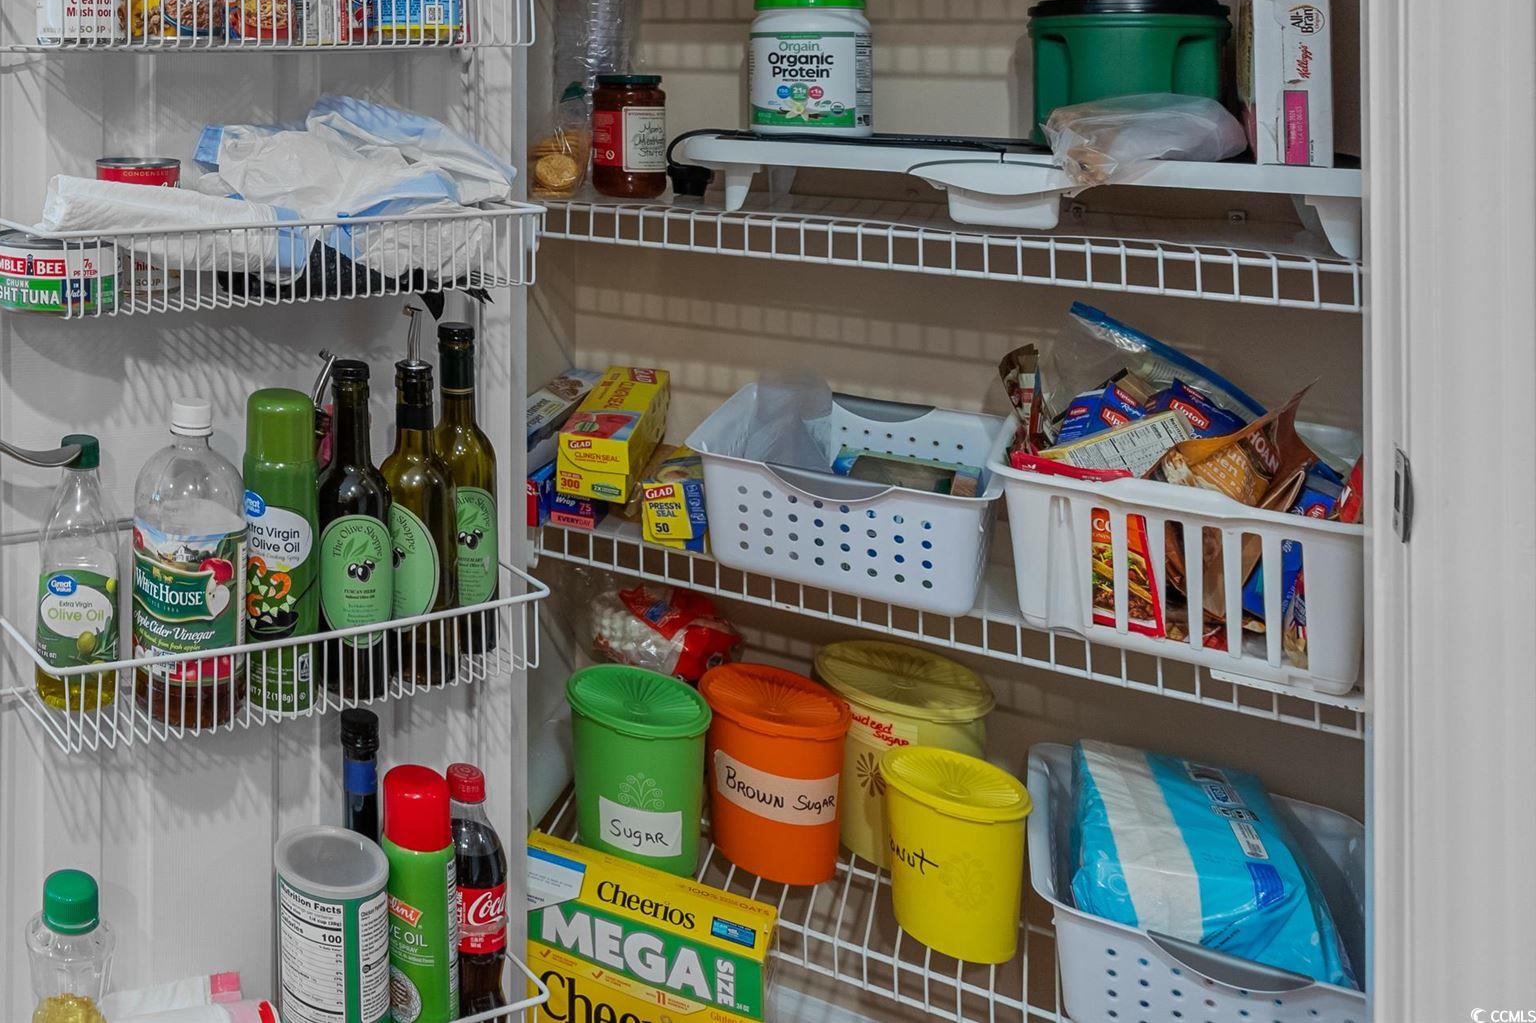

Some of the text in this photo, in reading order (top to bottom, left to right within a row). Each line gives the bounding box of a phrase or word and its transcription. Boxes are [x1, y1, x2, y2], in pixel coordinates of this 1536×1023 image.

[1301, 8, 1314, 34] Bran
[779, 41, 820, 54] Orgain
[768, 51, 834, 67] Organic
[1296, 42, 1313, 79] Kellogg's
[772, 66, 830, 78] Protein
[36, 261, 64, 274] BEE
[6, 279, 30, 287] CHUNK
[21, 289, 60, 305] TUNA
[1116, 388, 1137, 406] Lipton
[569, 441, 592, 449] GLAD
[561, 478, 580, 489] 300
[645, 488, 673, 498] GLAD
[556, 496, 576, 506] Wrap
[557, 517, 591, 527] EVERYDAY
[655, 523, 670, 533] 50
[266, 527, 300, 542] Virgin
[397, 515, 416, 550] Shoppe
[252, 537, 300, 553] Olive Oil
[332, 526, 384, 558] The Olive Shoppe
[50, 579, 71, 589] Great
[159, 583, 203, 606] HOUSE
[59, 600, 93, 609] Extra Virgin
[48, 607, 105, 621] Olive Oil
[133, 610, 215, 642] Apple Cider Vinegar
[726, 766, 784, 809] BROWN
[687, 886, 718, 902] 100%
[314, 901, 342, 914] Facts
[597, 880, 696, 930] Cheerios
[322, 934, 342, 944] 100
[404, 932, 428, 947] OIL
[542, 905, 712, 1001] MEGA
[717, 959, 735, 1008] SIZE
